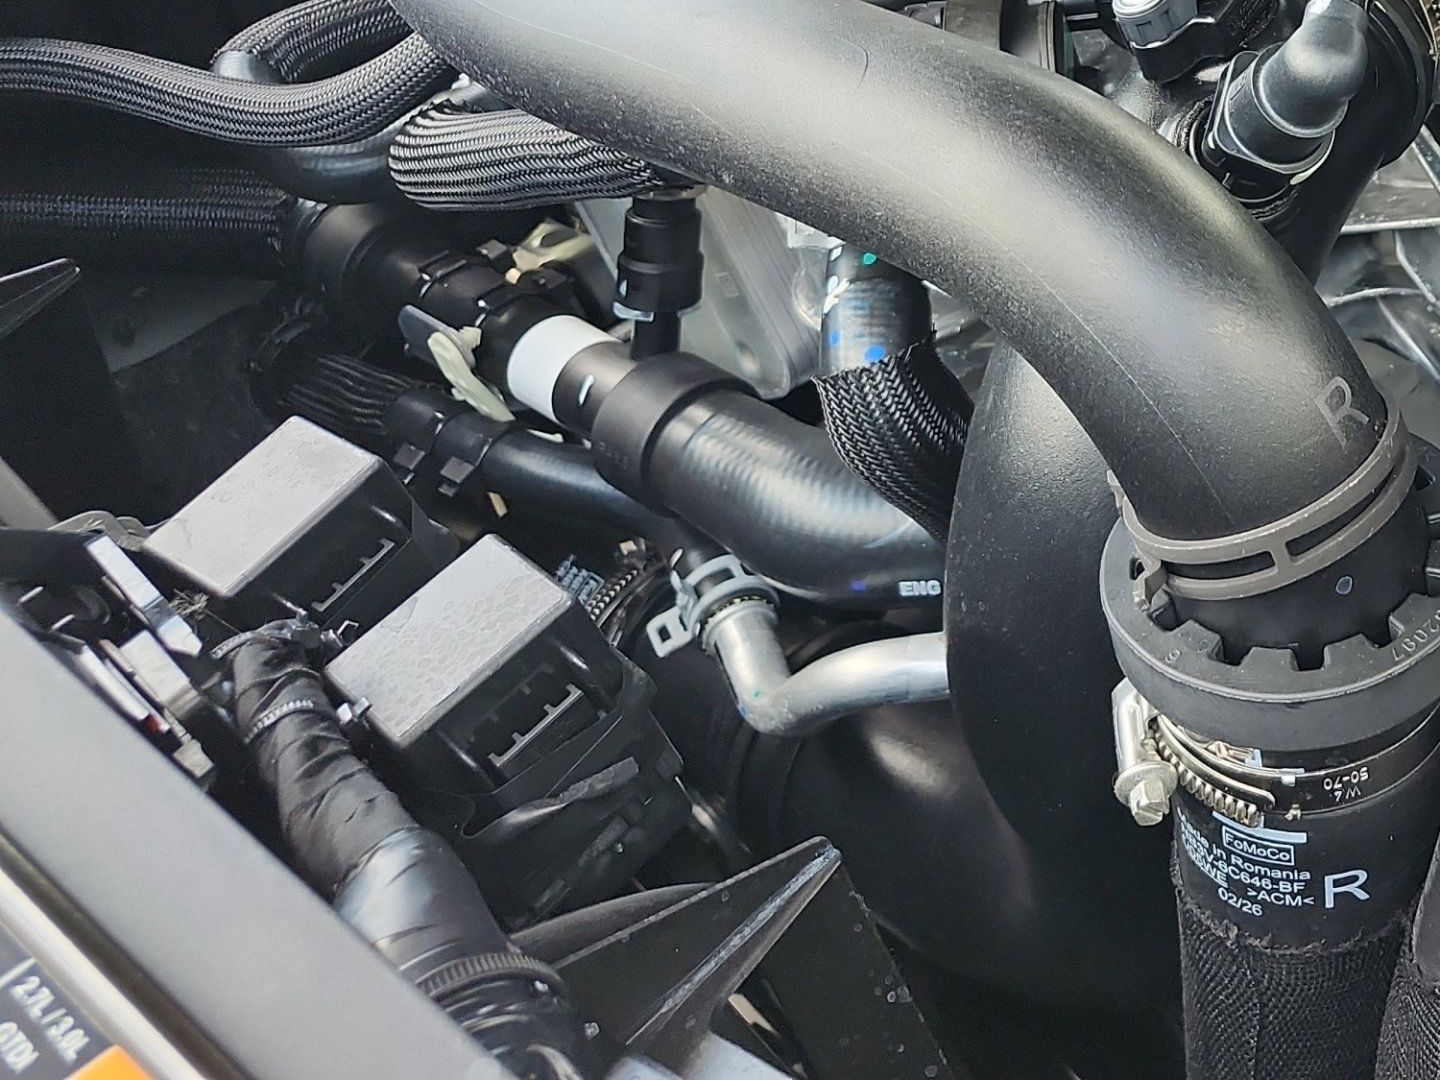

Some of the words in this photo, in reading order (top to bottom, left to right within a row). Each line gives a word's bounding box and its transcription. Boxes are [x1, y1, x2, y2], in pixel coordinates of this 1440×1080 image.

[1314, 376, 1369, 450] R
[899, 580, 941, 597] ENG
[1323, 766, 1369, 791] 50-70
[1212, 843, 1227, 861] in
[1231, 853, 1311, 881] Romania
[1224, 831, 1291, 862] FoMoCo
[1218, 887, 1263, 917] 02/26
[1324, 869, 1371, 909] R
